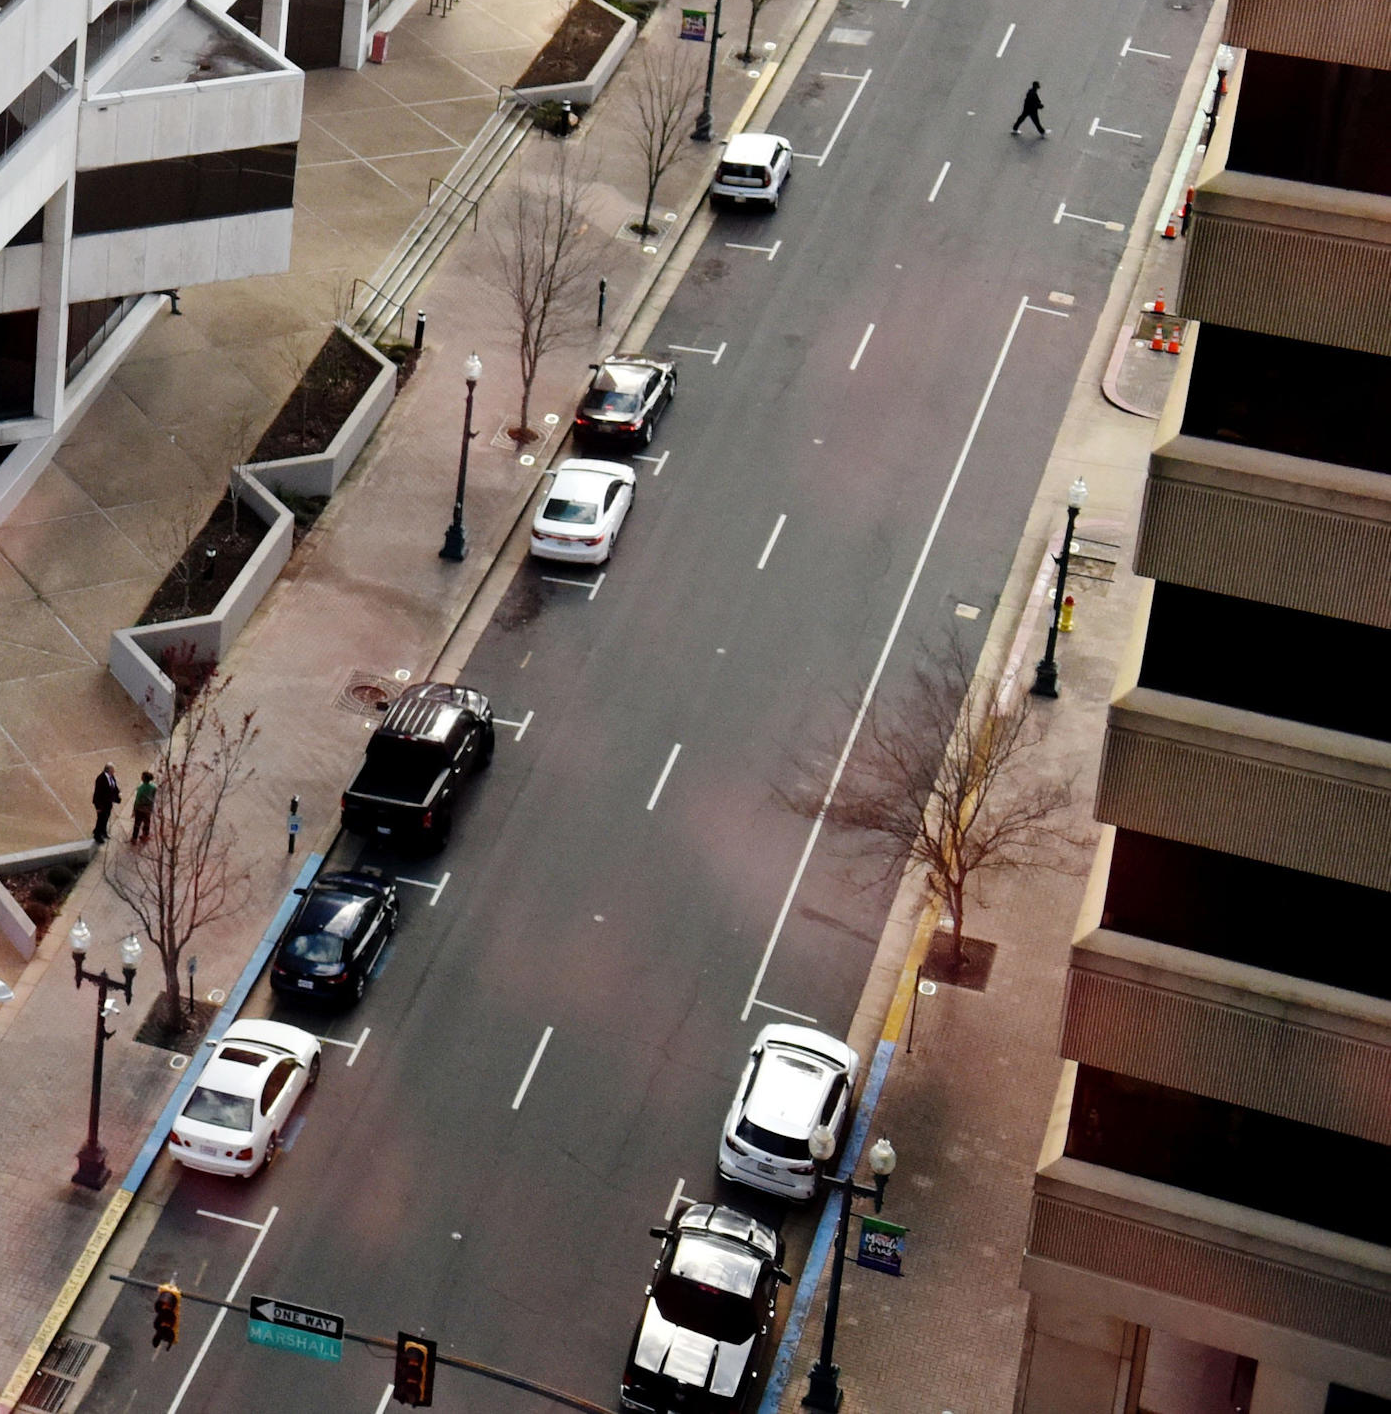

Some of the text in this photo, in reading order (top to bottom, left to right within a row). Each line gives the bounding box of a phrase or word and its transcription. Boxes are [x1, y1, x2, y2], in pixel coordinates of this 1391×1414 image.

[868, 1243, 893, 1256] Gras
[274, 1307, 332, 1329] ONE WAY
[249, 1326, 339, 1358] MARSHALL
